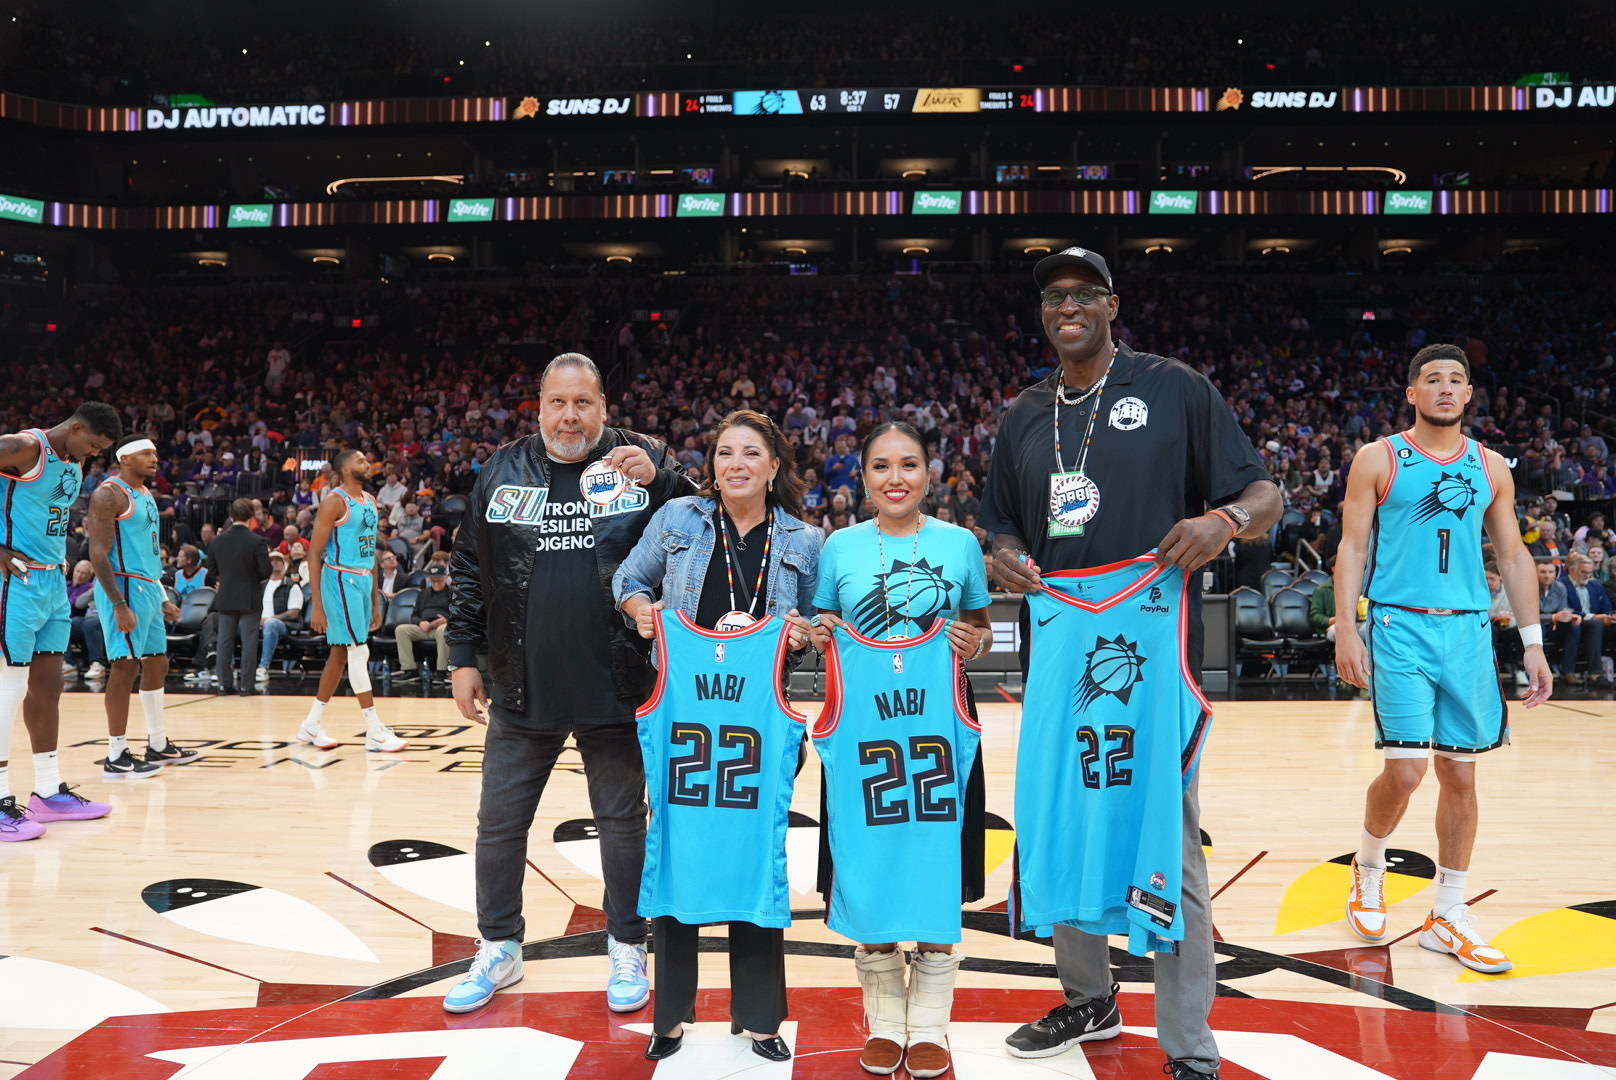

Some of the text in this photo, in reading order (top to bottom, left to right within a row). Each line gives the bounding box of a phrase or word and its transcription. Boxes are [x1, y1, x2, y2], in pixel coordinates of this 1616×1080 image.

[810, 95, 826, 110] 63
[840, 91, 867, 105] 8:37
[884, 94, 900, 109] 57
[1250, 92, 1337, 108] SUNS DJ
[1536, 86, 1616, 108] DJ AU
[546, 98, 630, 115] SUNS DJ
[147, 105, 325, 129] DJ AUTOMATIC
[453, 201, 489, 216] Sprite
[682, 196, 720, 212] Sprite
[917, 193, 957, 209] Sprite
[1154, 193, 1193, 209] Sprite
[1389, 193, 1428, 209] Sprite
[232, 206, 268, 222] Sprite
[300, 460, 329, 471] SUN
[1437, 528, 1451, 574] 1
[1140, 604, 1170, 613] PayPal
[694, 673, 746, 703] NABI
[874, 688, 926, 721] NABI
[1076, 724, 1136, 790] 22
[667, 721, 762, 810] 22
[858, 734, 958, 827] 22
